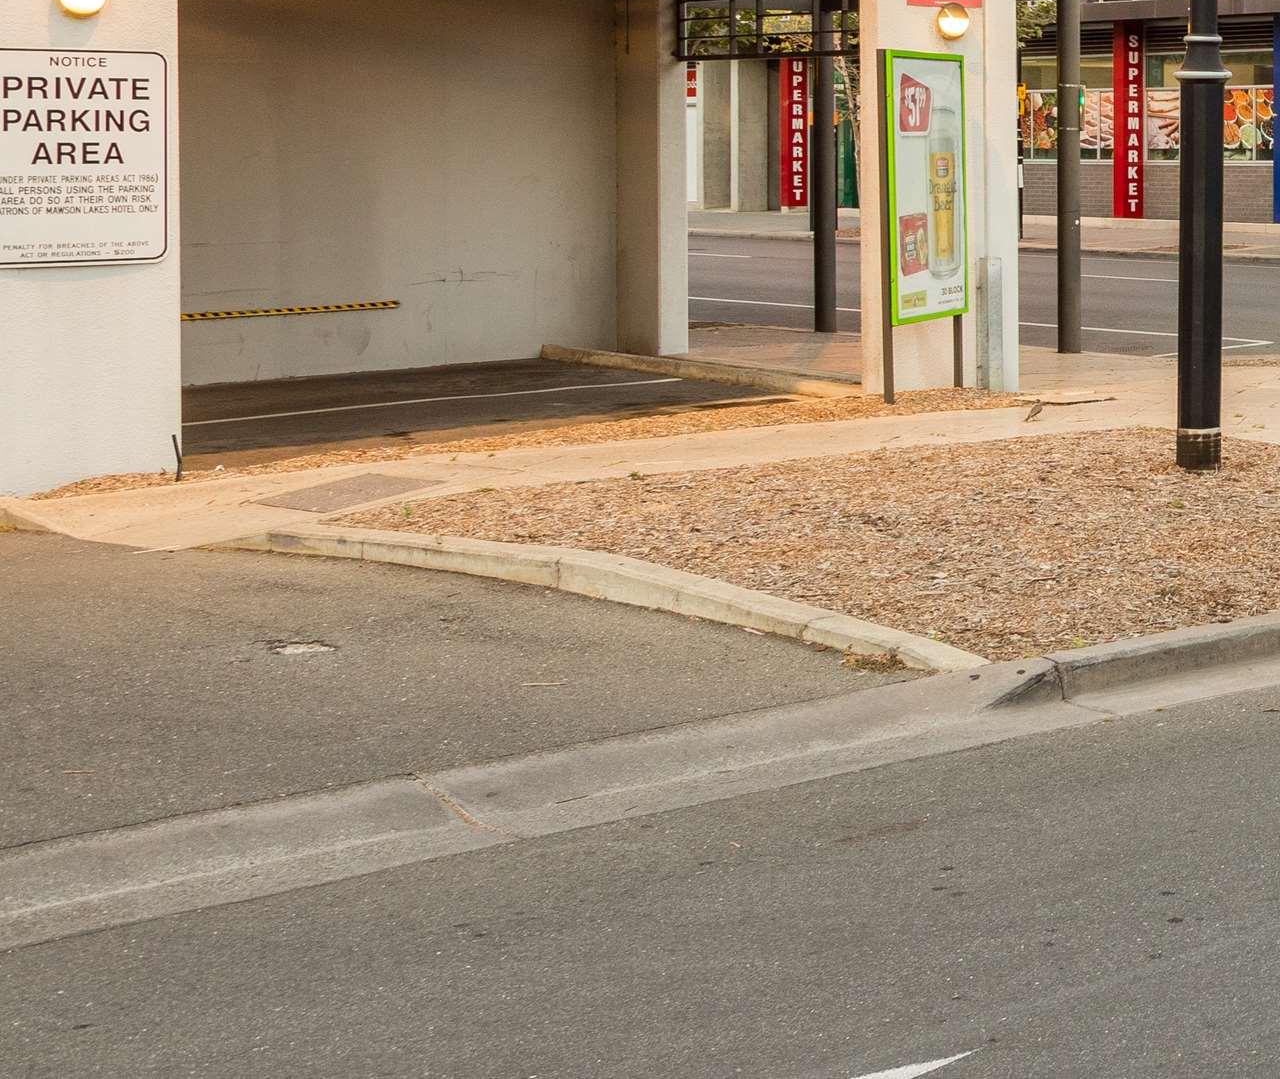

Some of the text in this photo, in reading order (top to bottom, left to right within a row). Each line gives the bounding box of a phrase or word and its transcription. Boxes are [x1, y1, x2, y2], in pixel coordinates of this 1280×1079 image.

[49, 56, 108, 67] NOTICE
[3, 77, 150, 100] PRIVATE
[3, 109, 150, 132] PARKING
[1128, 35, 1140, 212] SUPERMARKET
[792, 61, 804, 201] UPERMARKET
[31, 142, 124, 165] AREA
[27, 175, 57, 184] PRIVATE
[61, 175, 93, 183] PARKING
[96, 174, 119, 183] AREAS
[122, 174, 136, 182] ACT
[18, 186, 62, 195] PERSONS
[66, 185, 94, 194] USING
[98, 185, 115, 194] THE
[118, 184, 155, 193] PARKING
[1, 195, 152, 205] AREA DO SO AT THEIR OWN RISK
[32, 206, 43, 215] OF
[45, 206, 81, 215] MAWSON
[83, 205, 109, 214] LAKES
[111, 205, 136, 213] HOTEL
[138, 204, 159, 213] ONLY
